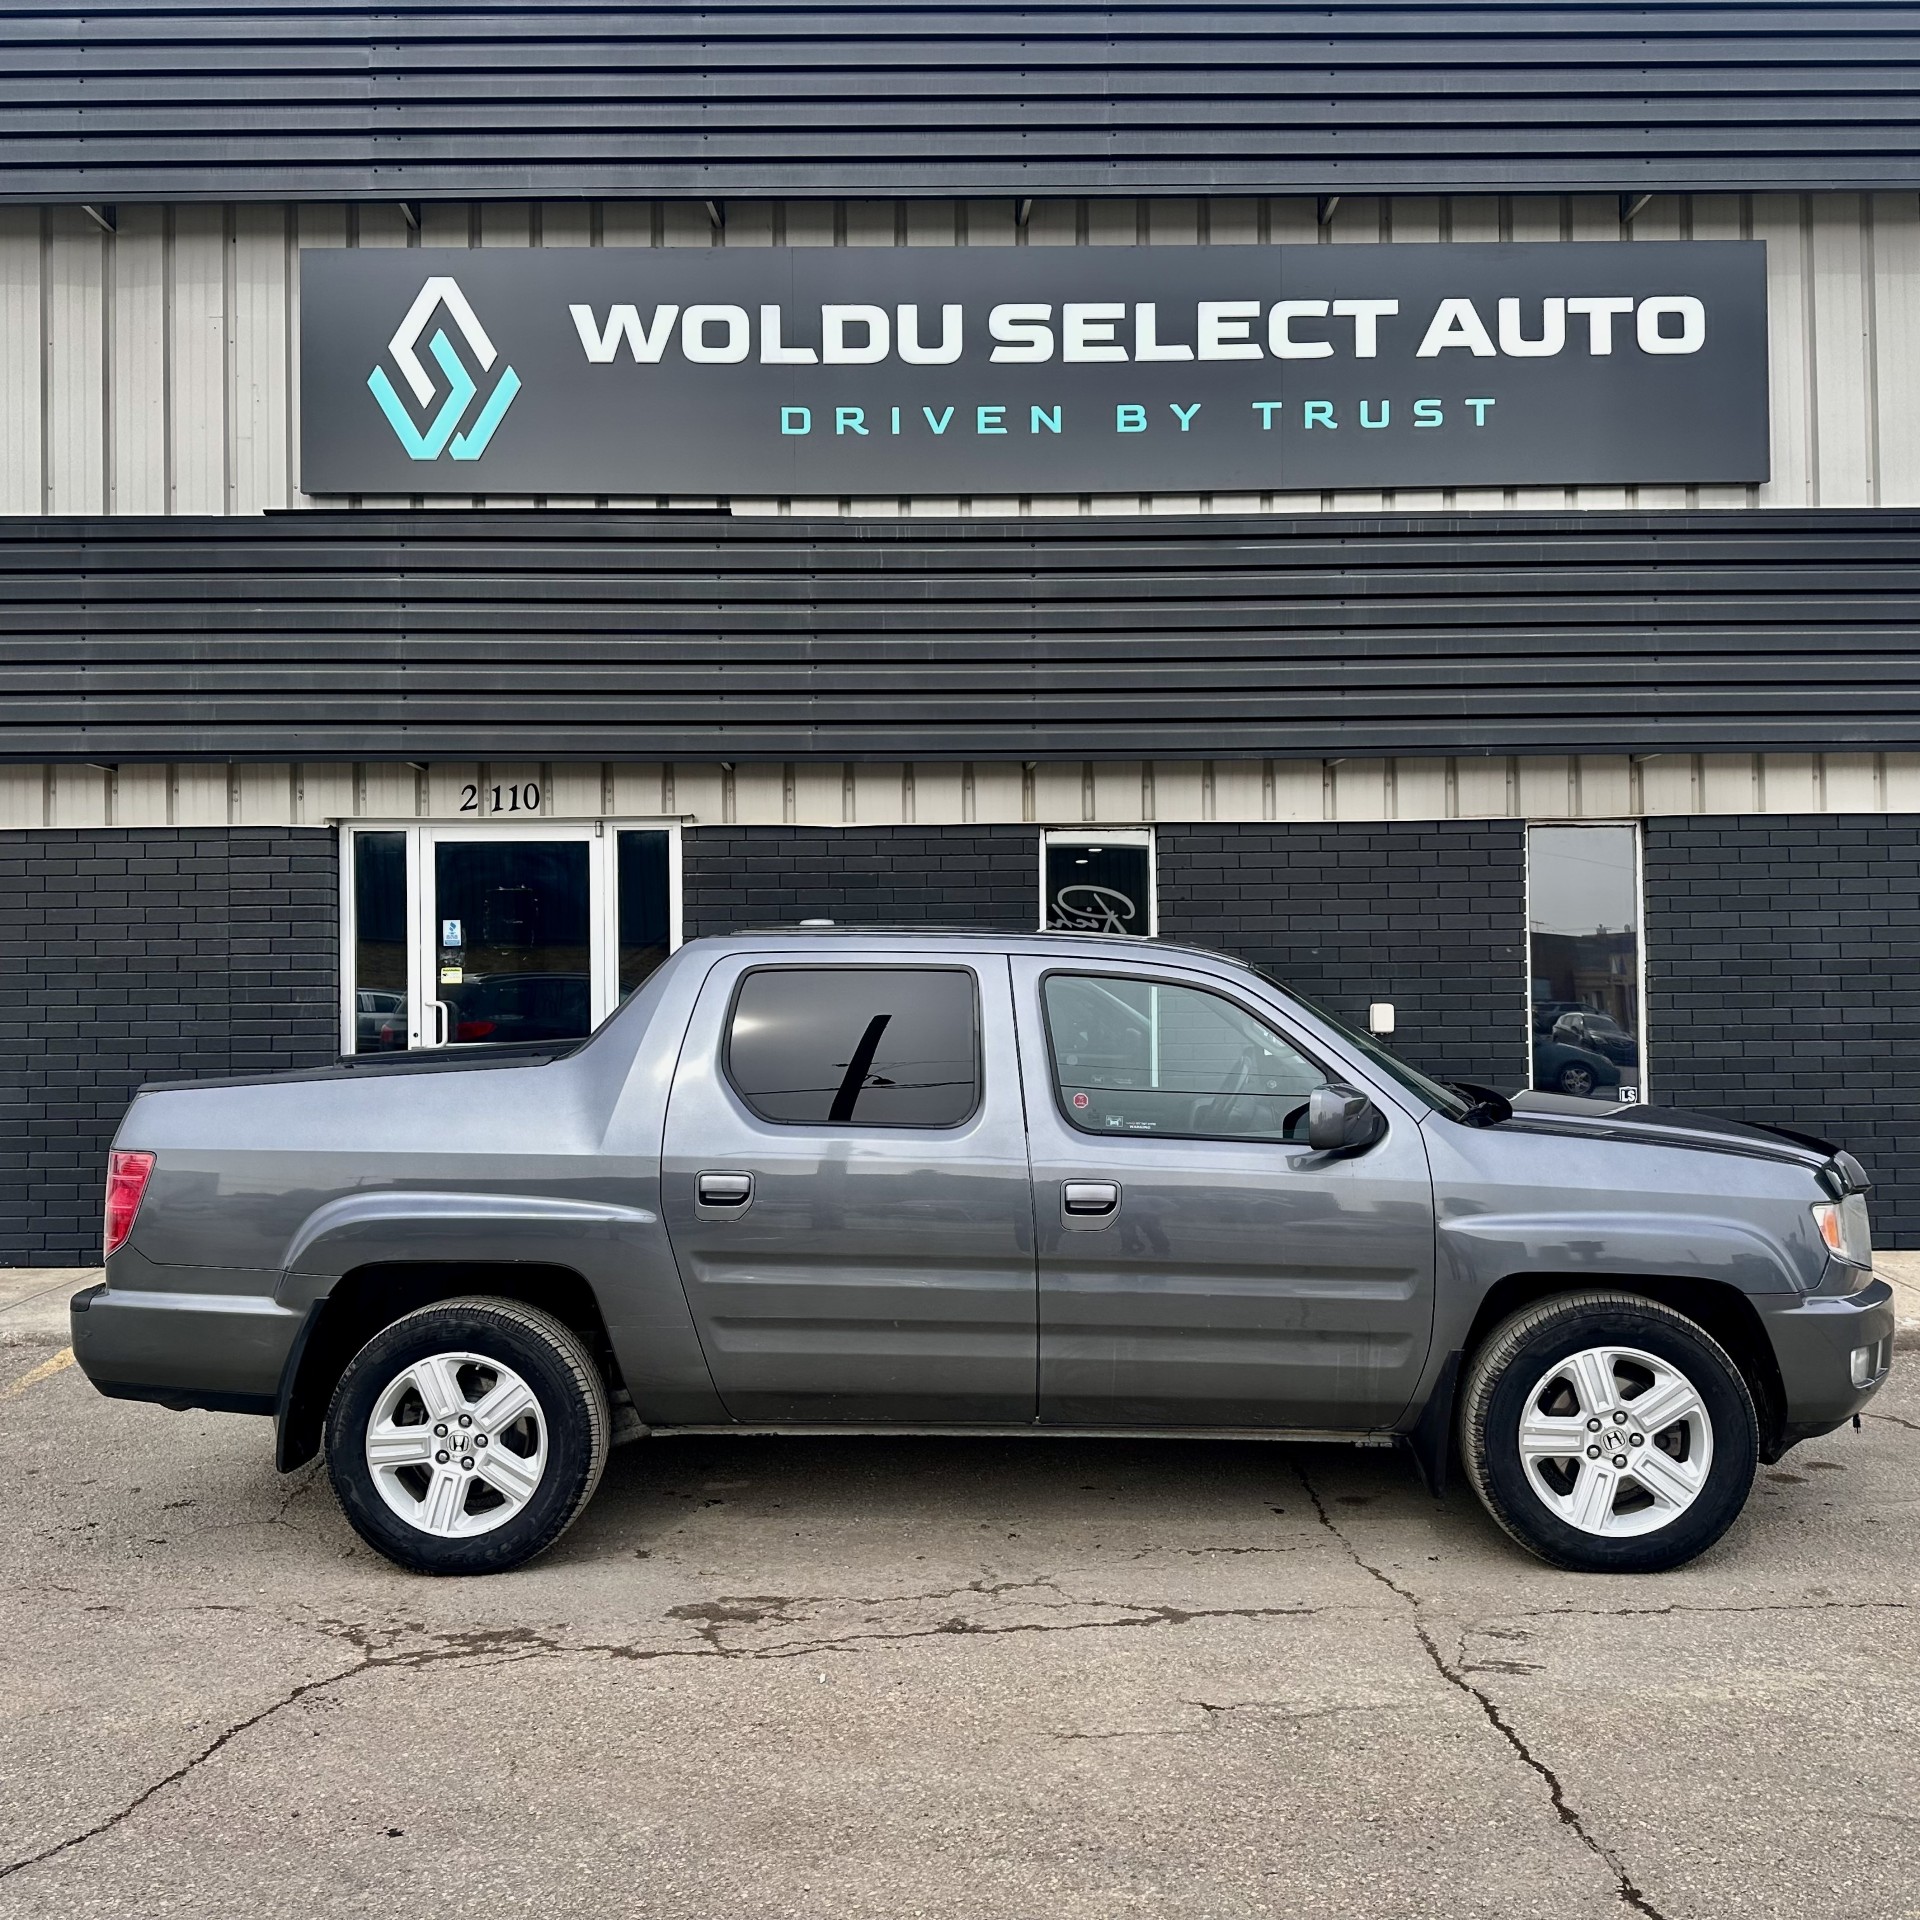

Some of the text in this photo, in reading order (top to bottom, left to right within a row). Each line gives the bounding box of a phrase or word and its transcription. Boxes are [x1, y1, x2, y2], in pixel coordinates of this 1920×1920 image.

[568, 296, 1706, 365] WOLDU SELECT AUTO
[780, 397, 1497, 435] DRIVEN BY TRUST
[1621, 1090, 1636, 1102] LS
